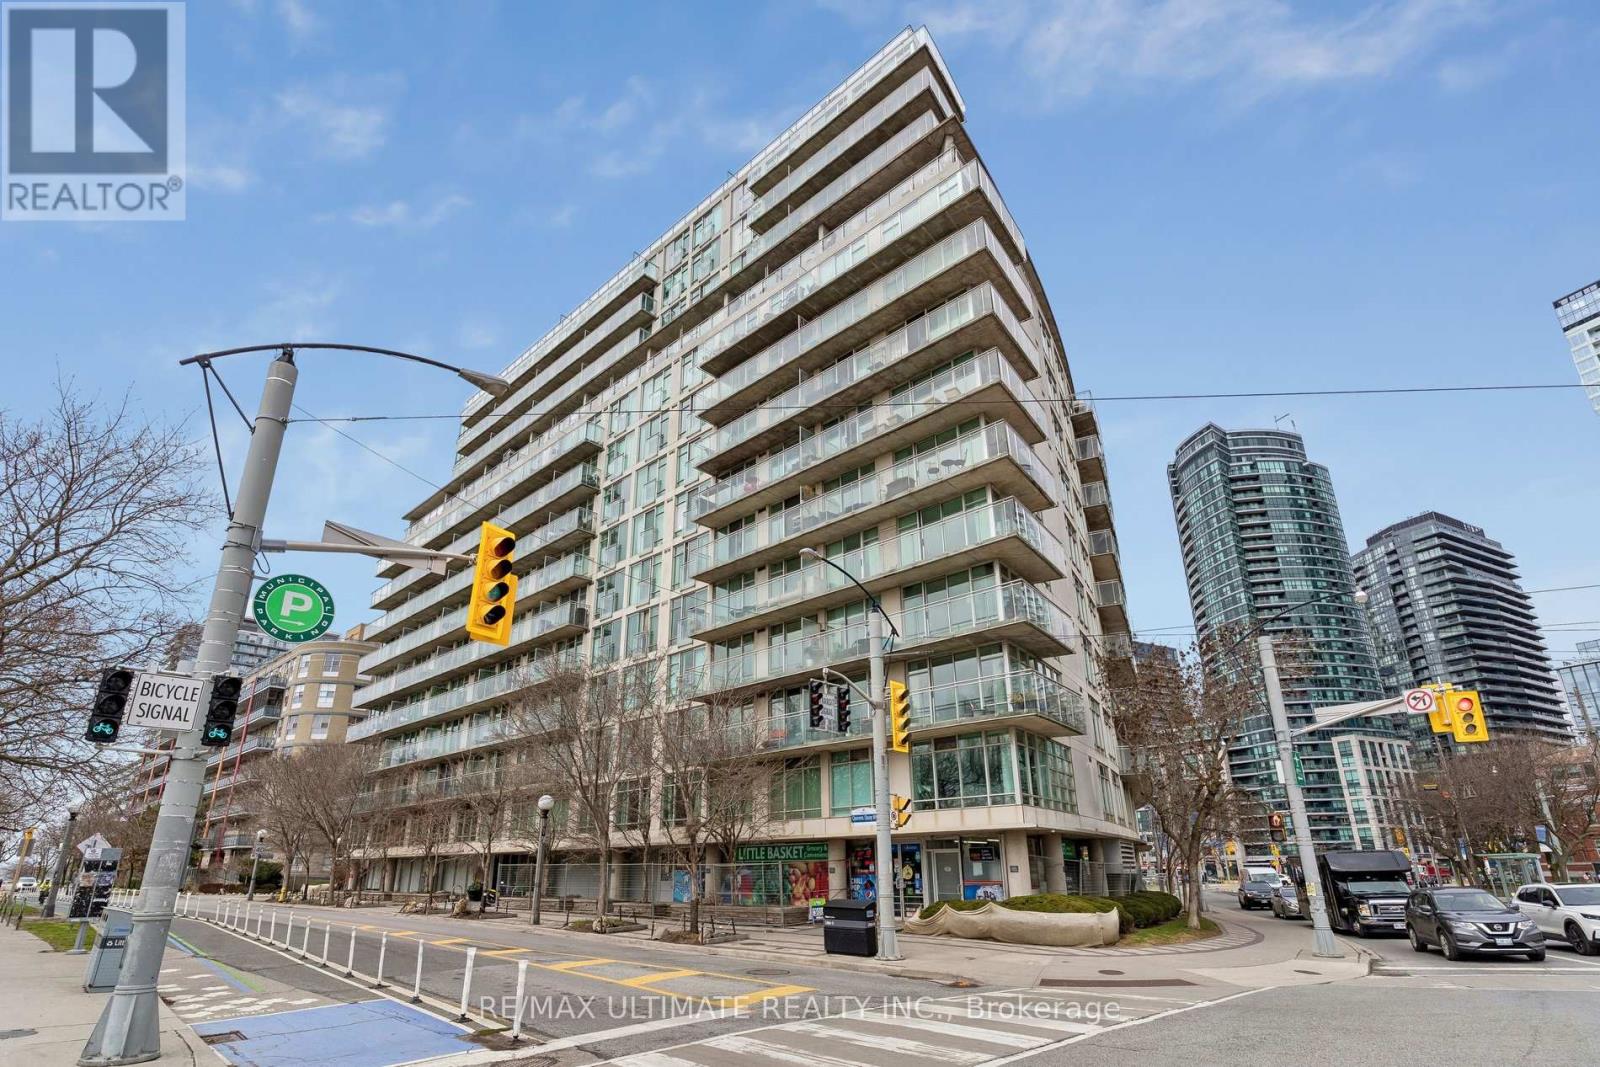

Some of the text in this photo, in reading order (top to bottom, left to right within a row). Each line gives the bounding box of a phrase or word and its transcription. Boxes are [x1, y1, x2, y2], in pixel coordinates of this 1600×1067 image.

[259, 577, 332, 611] MUNICIPAL
[280, 590, 313, 617] P
[256, 608, 328, 640] PARKING
[140, 681, 200, 702] BICYCLE
[136, 702, 190, 723] SIGNAL
[738, 846, 805, 860] LITTLE BASKET
